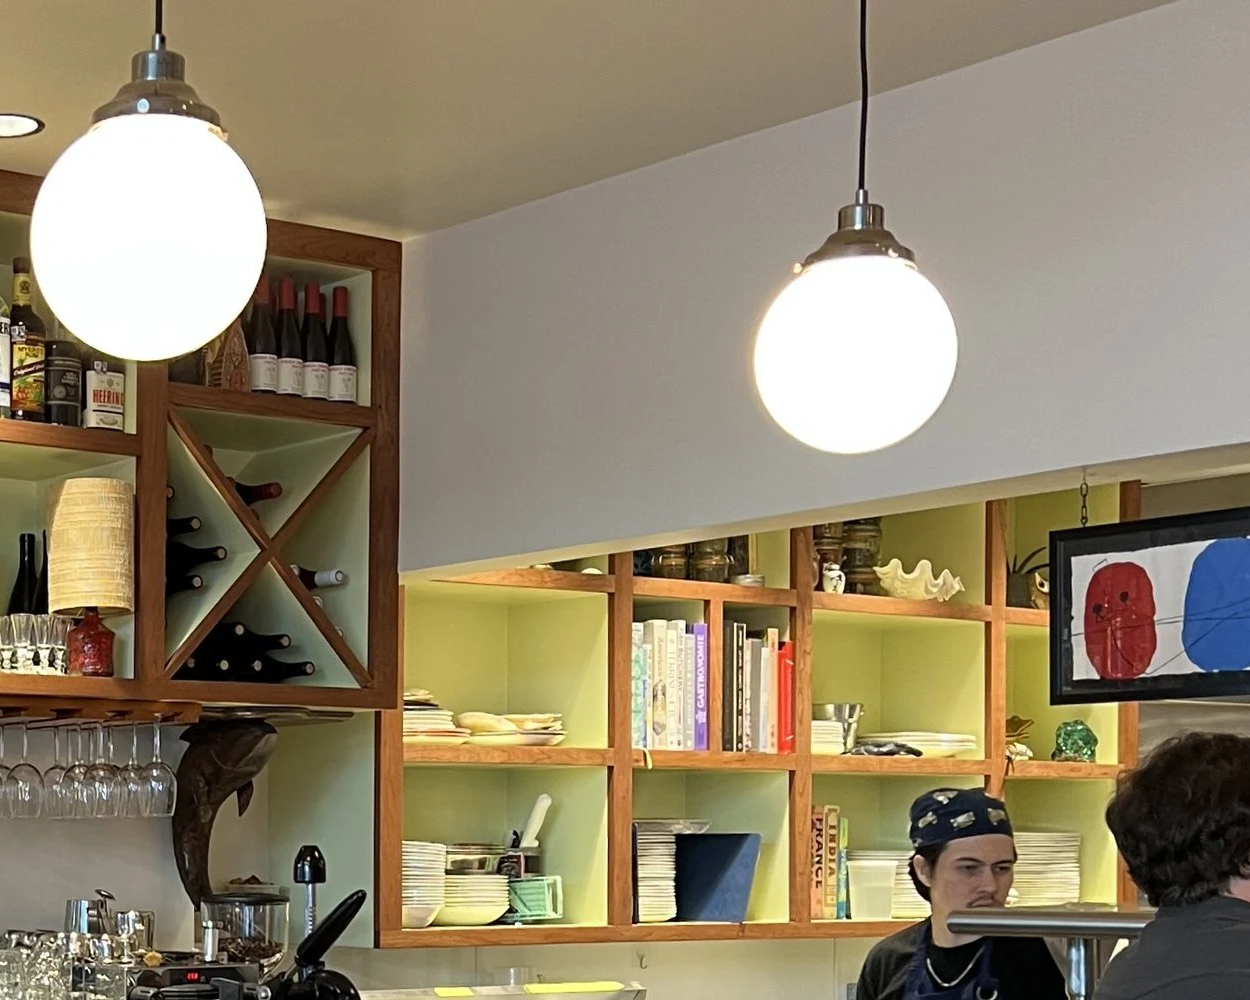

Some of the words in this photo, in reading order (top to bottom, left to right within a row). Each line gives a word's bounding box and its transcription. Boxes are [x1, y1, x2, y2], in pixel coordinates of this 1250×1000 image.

[696, 634, 705, 708] GASTRONOMIE
[815, 818, 824, 889] FRANCE
[828, 825, 837, 877] INDIA
